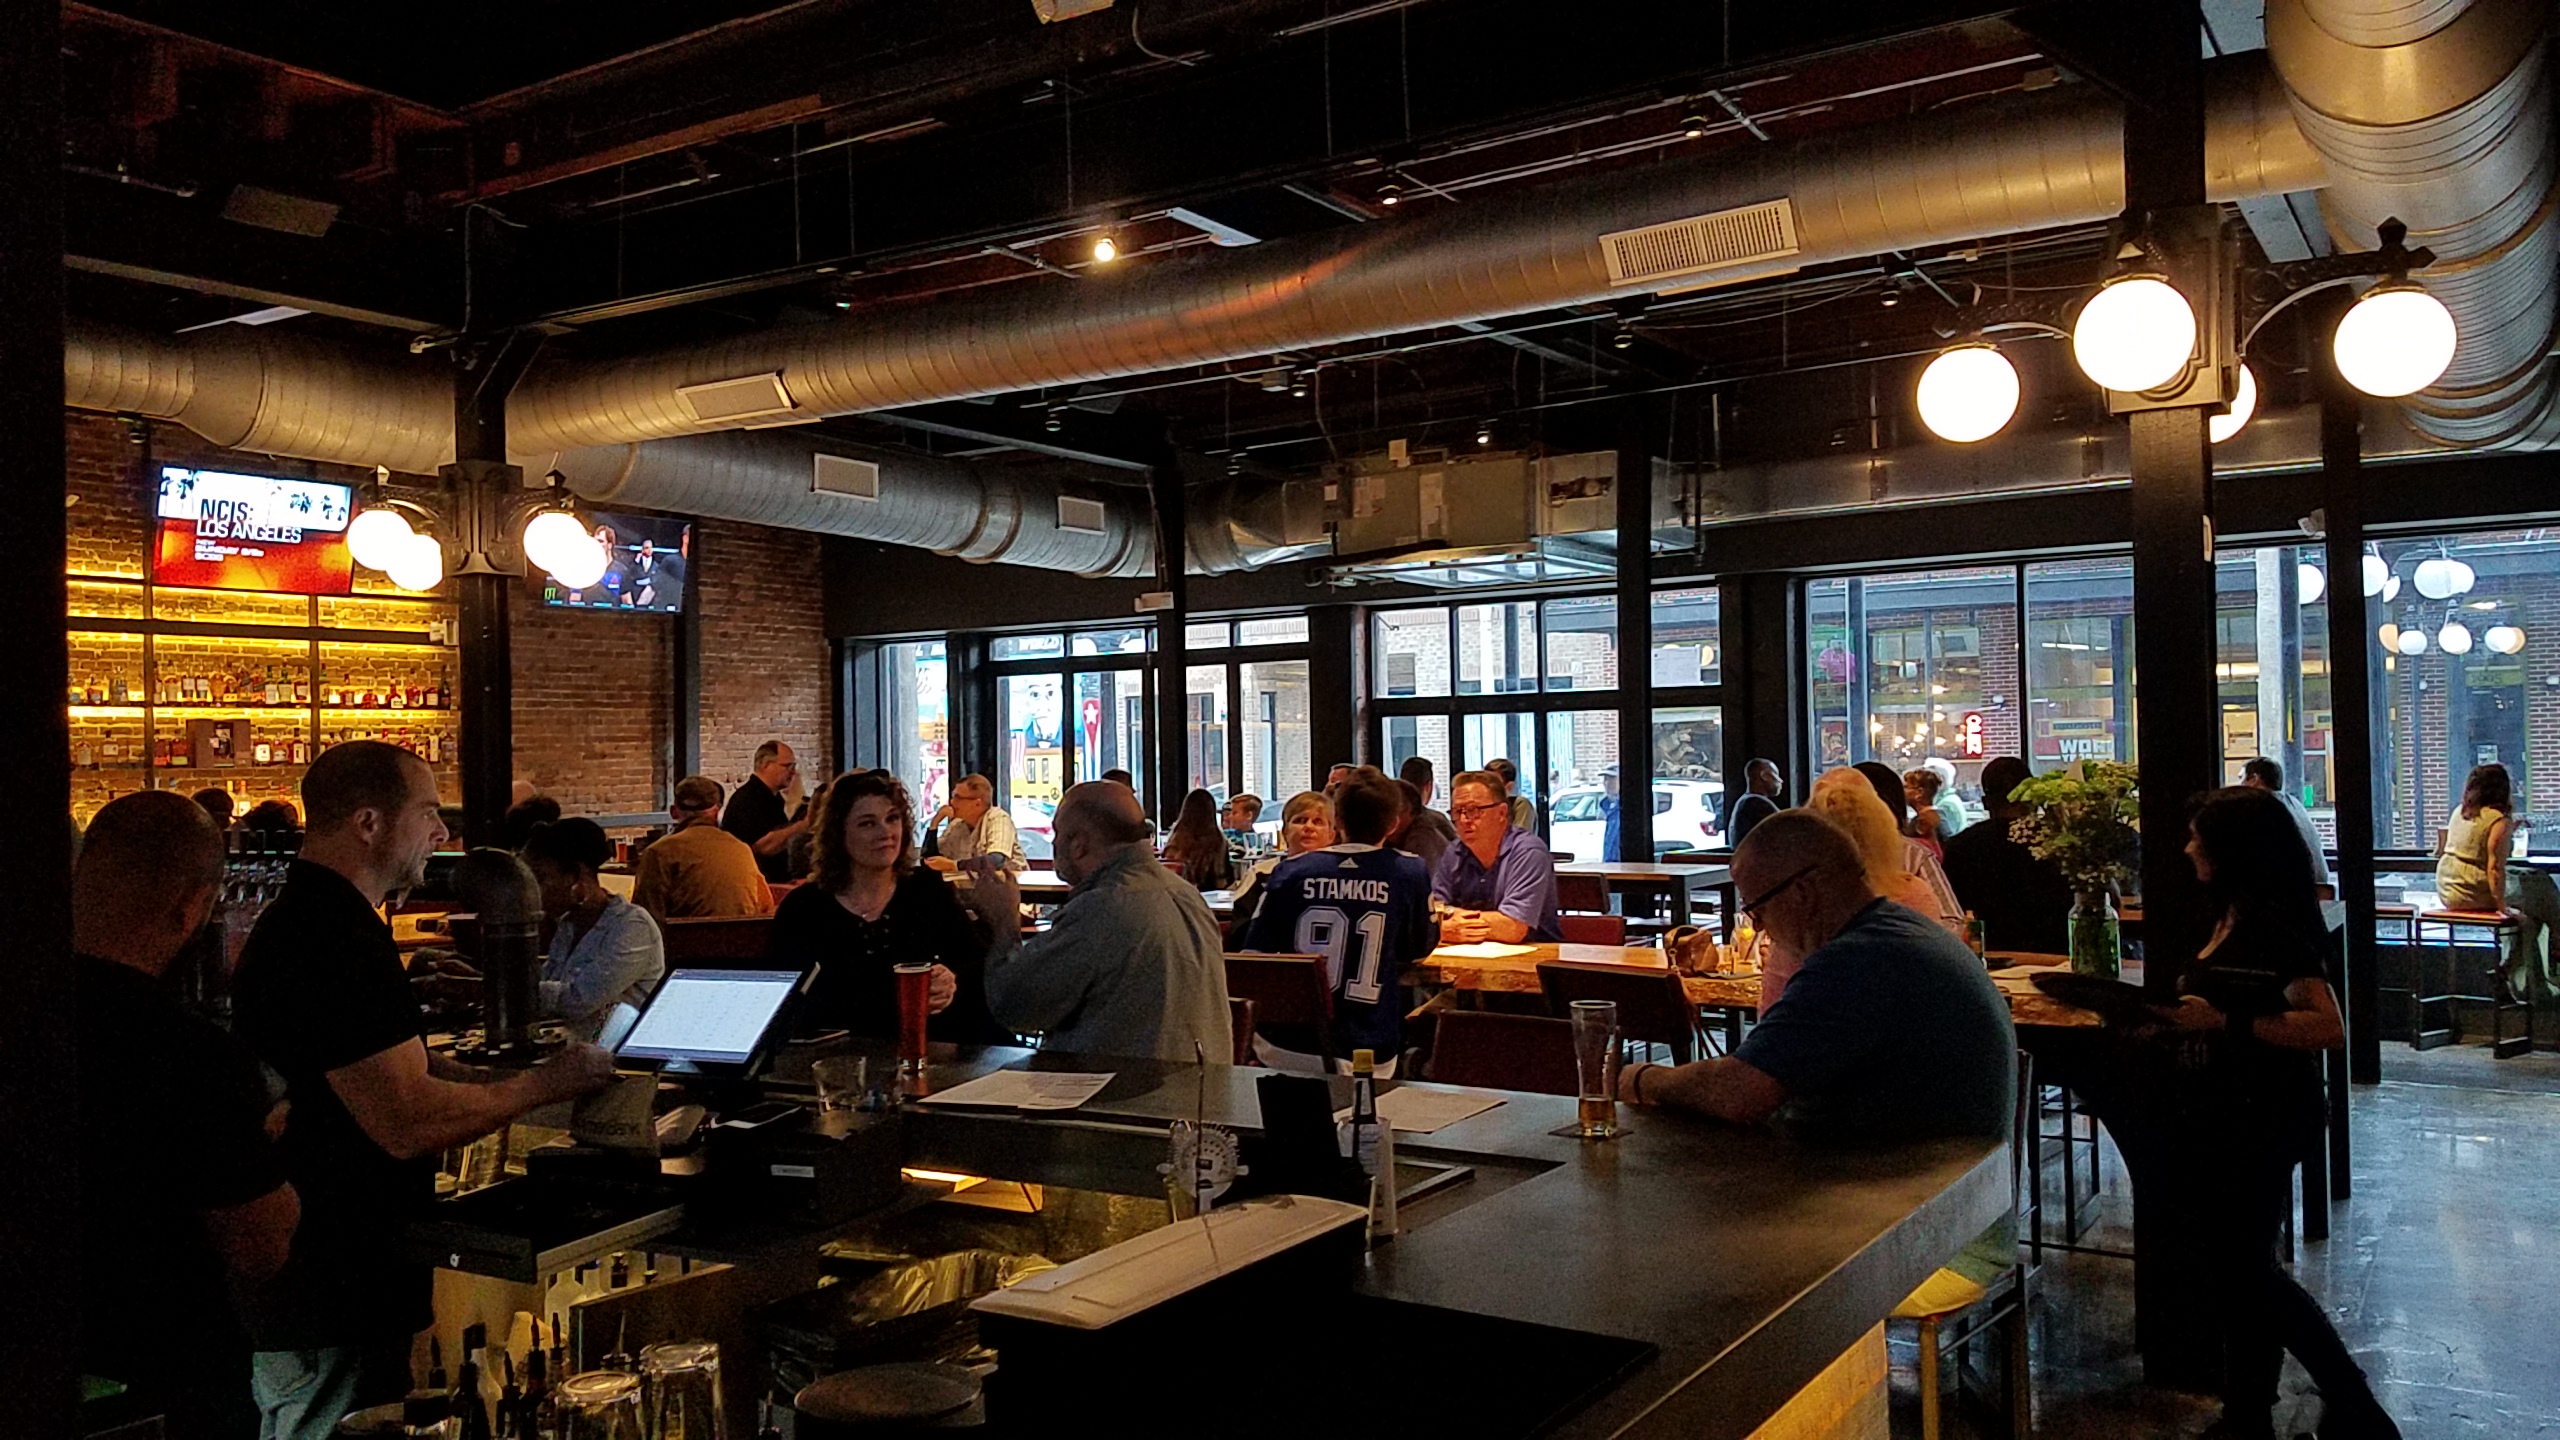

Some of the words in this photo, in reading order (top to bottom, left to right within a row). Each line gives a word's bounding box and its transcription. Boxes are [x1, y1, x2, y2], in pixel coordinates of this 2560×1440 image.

[200, 498, 254, 522] NCIS:
[197, 519, 228, 537] LOS
[231, 521, 302, 544] ANGELES
[1302, 877, 1389, 904] STAMKOS
[1294, 905, 1386, 1005] 91
